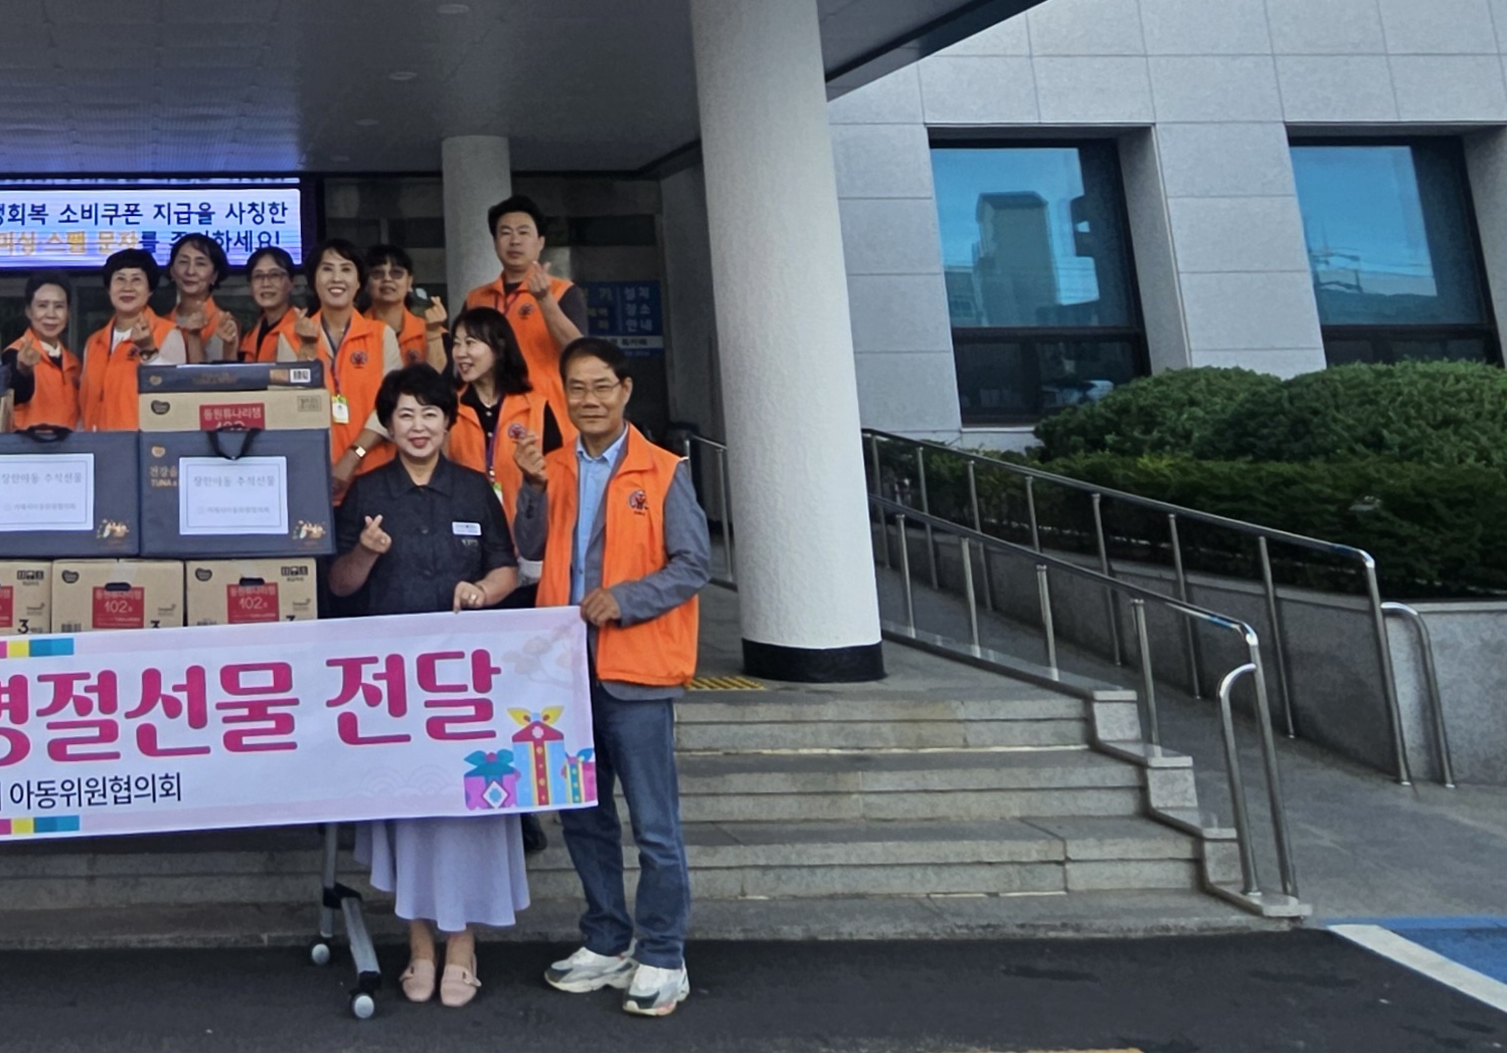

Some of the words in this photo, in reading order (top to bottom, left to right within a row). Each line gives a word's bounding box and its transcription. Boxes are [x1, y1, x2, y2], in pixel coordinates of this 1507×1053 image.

[58, 202, 144, 226] 소비쿠폰
[152, 202, 217, 226] 지급을
[224, 201, 288, 226] 사칭한
[325, 648, 502, 746] 전달
[9, 772, 184, 808] 아동위원협의회
